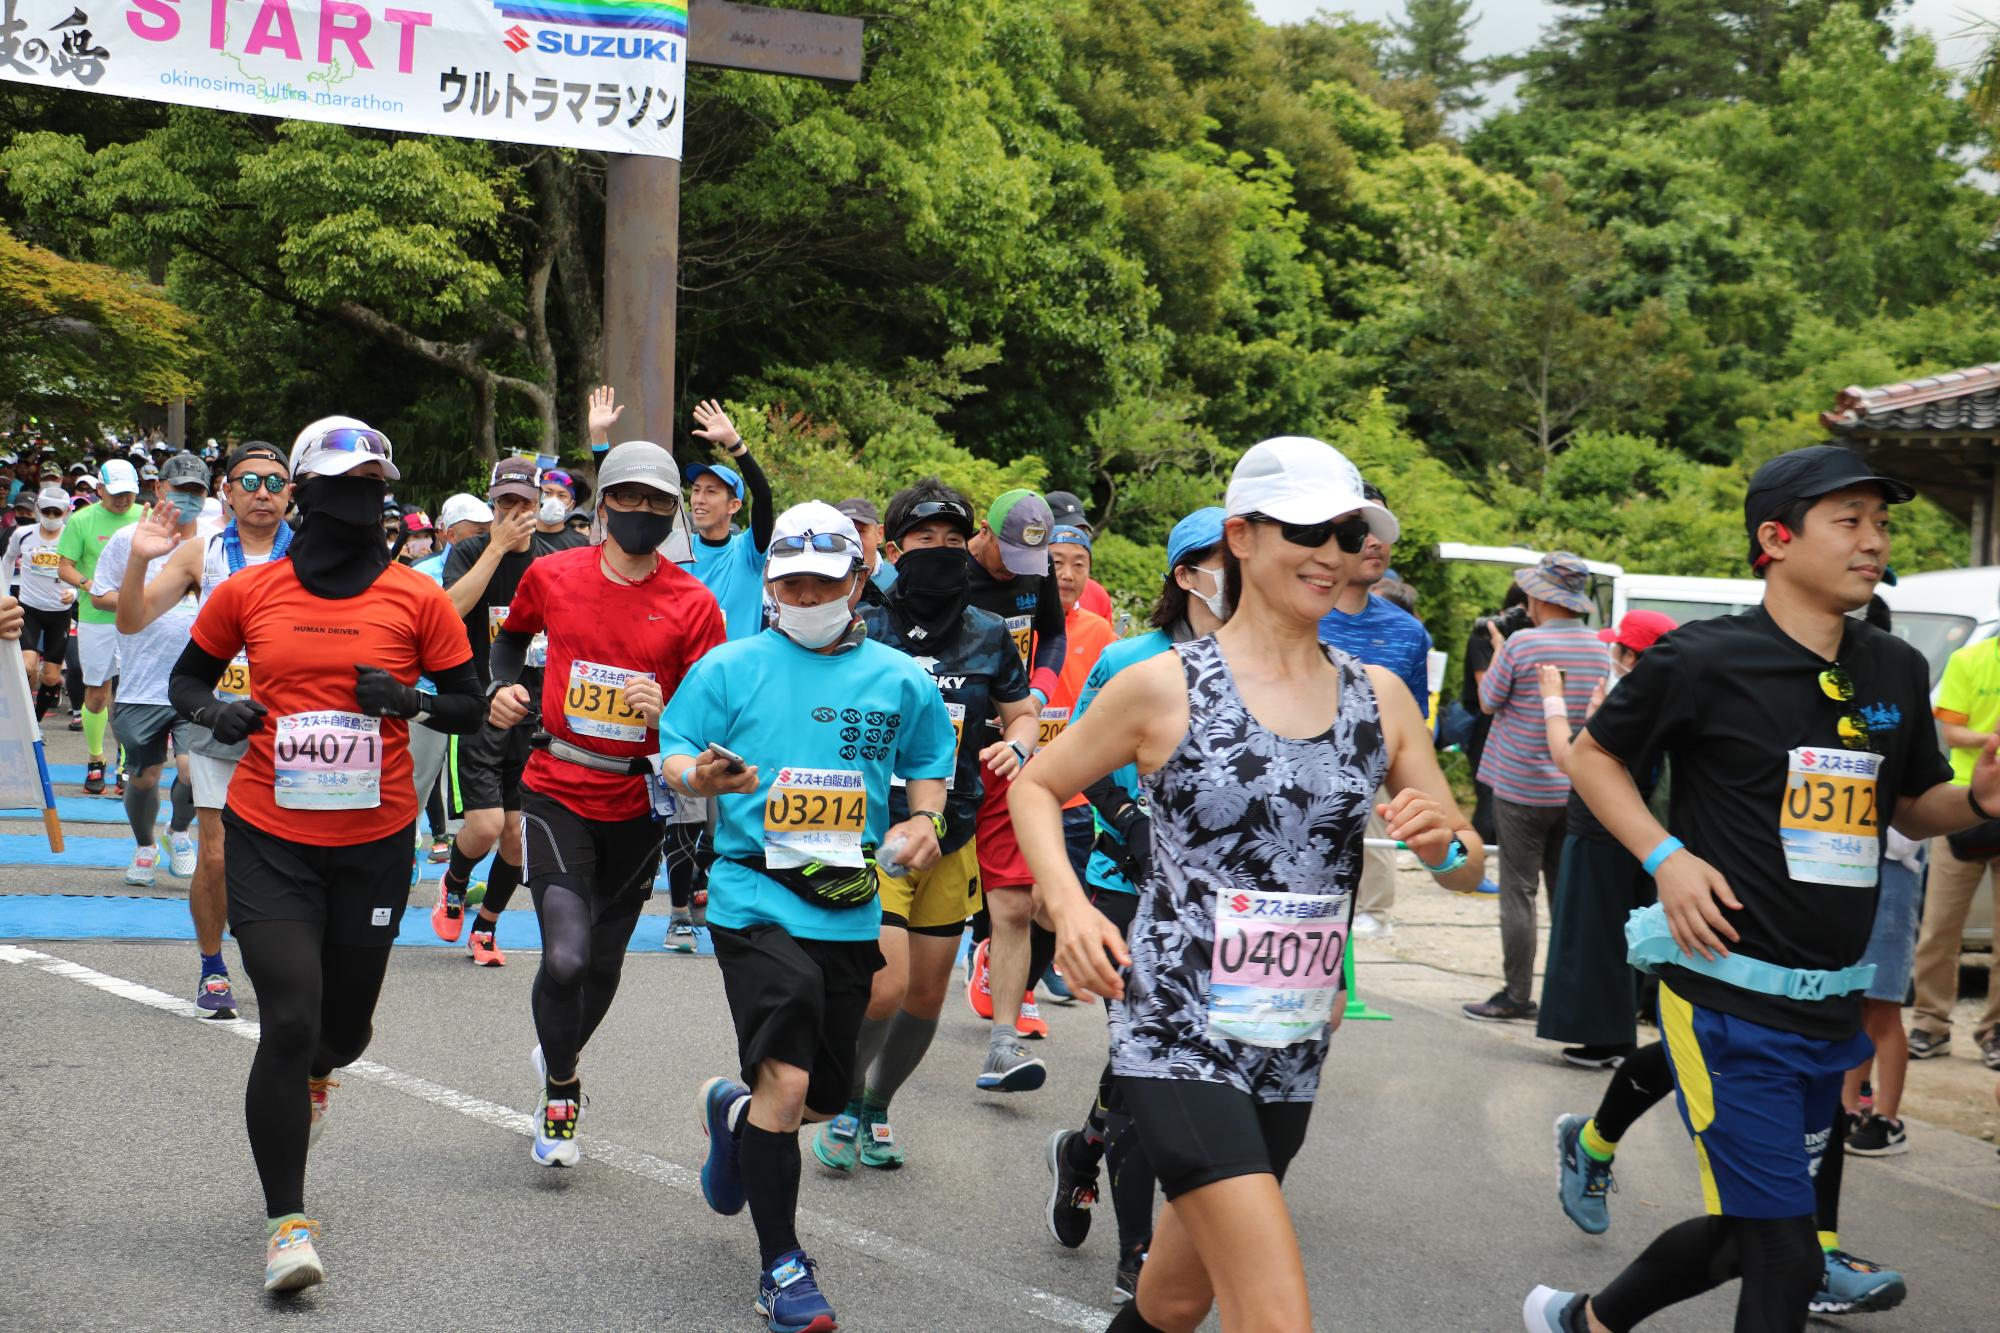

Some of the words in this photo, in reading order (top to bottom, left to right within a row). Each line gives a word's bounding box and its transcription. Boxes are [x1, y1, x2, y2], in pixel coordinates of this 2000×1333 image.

[126, 0, 432, 73] START
[536, 30, 677, 64] SUZUKI
[160, 69, 257, 95] okinosima
[264, 83, 307, 101] ultra
[316, 90, 404, 113] marathon
[440, 66, 677, 131] ウルトラマラソン
[294, 625, 326, 633] HUMAN
[328, 627, 360, 636] DRIVEN
[278, 733, 375, 763] 04071
[769, 793, 864, 827] 03214
[1788, 779, 1877, 826] 0312
[1220, 927, 1342, 977] 04070
